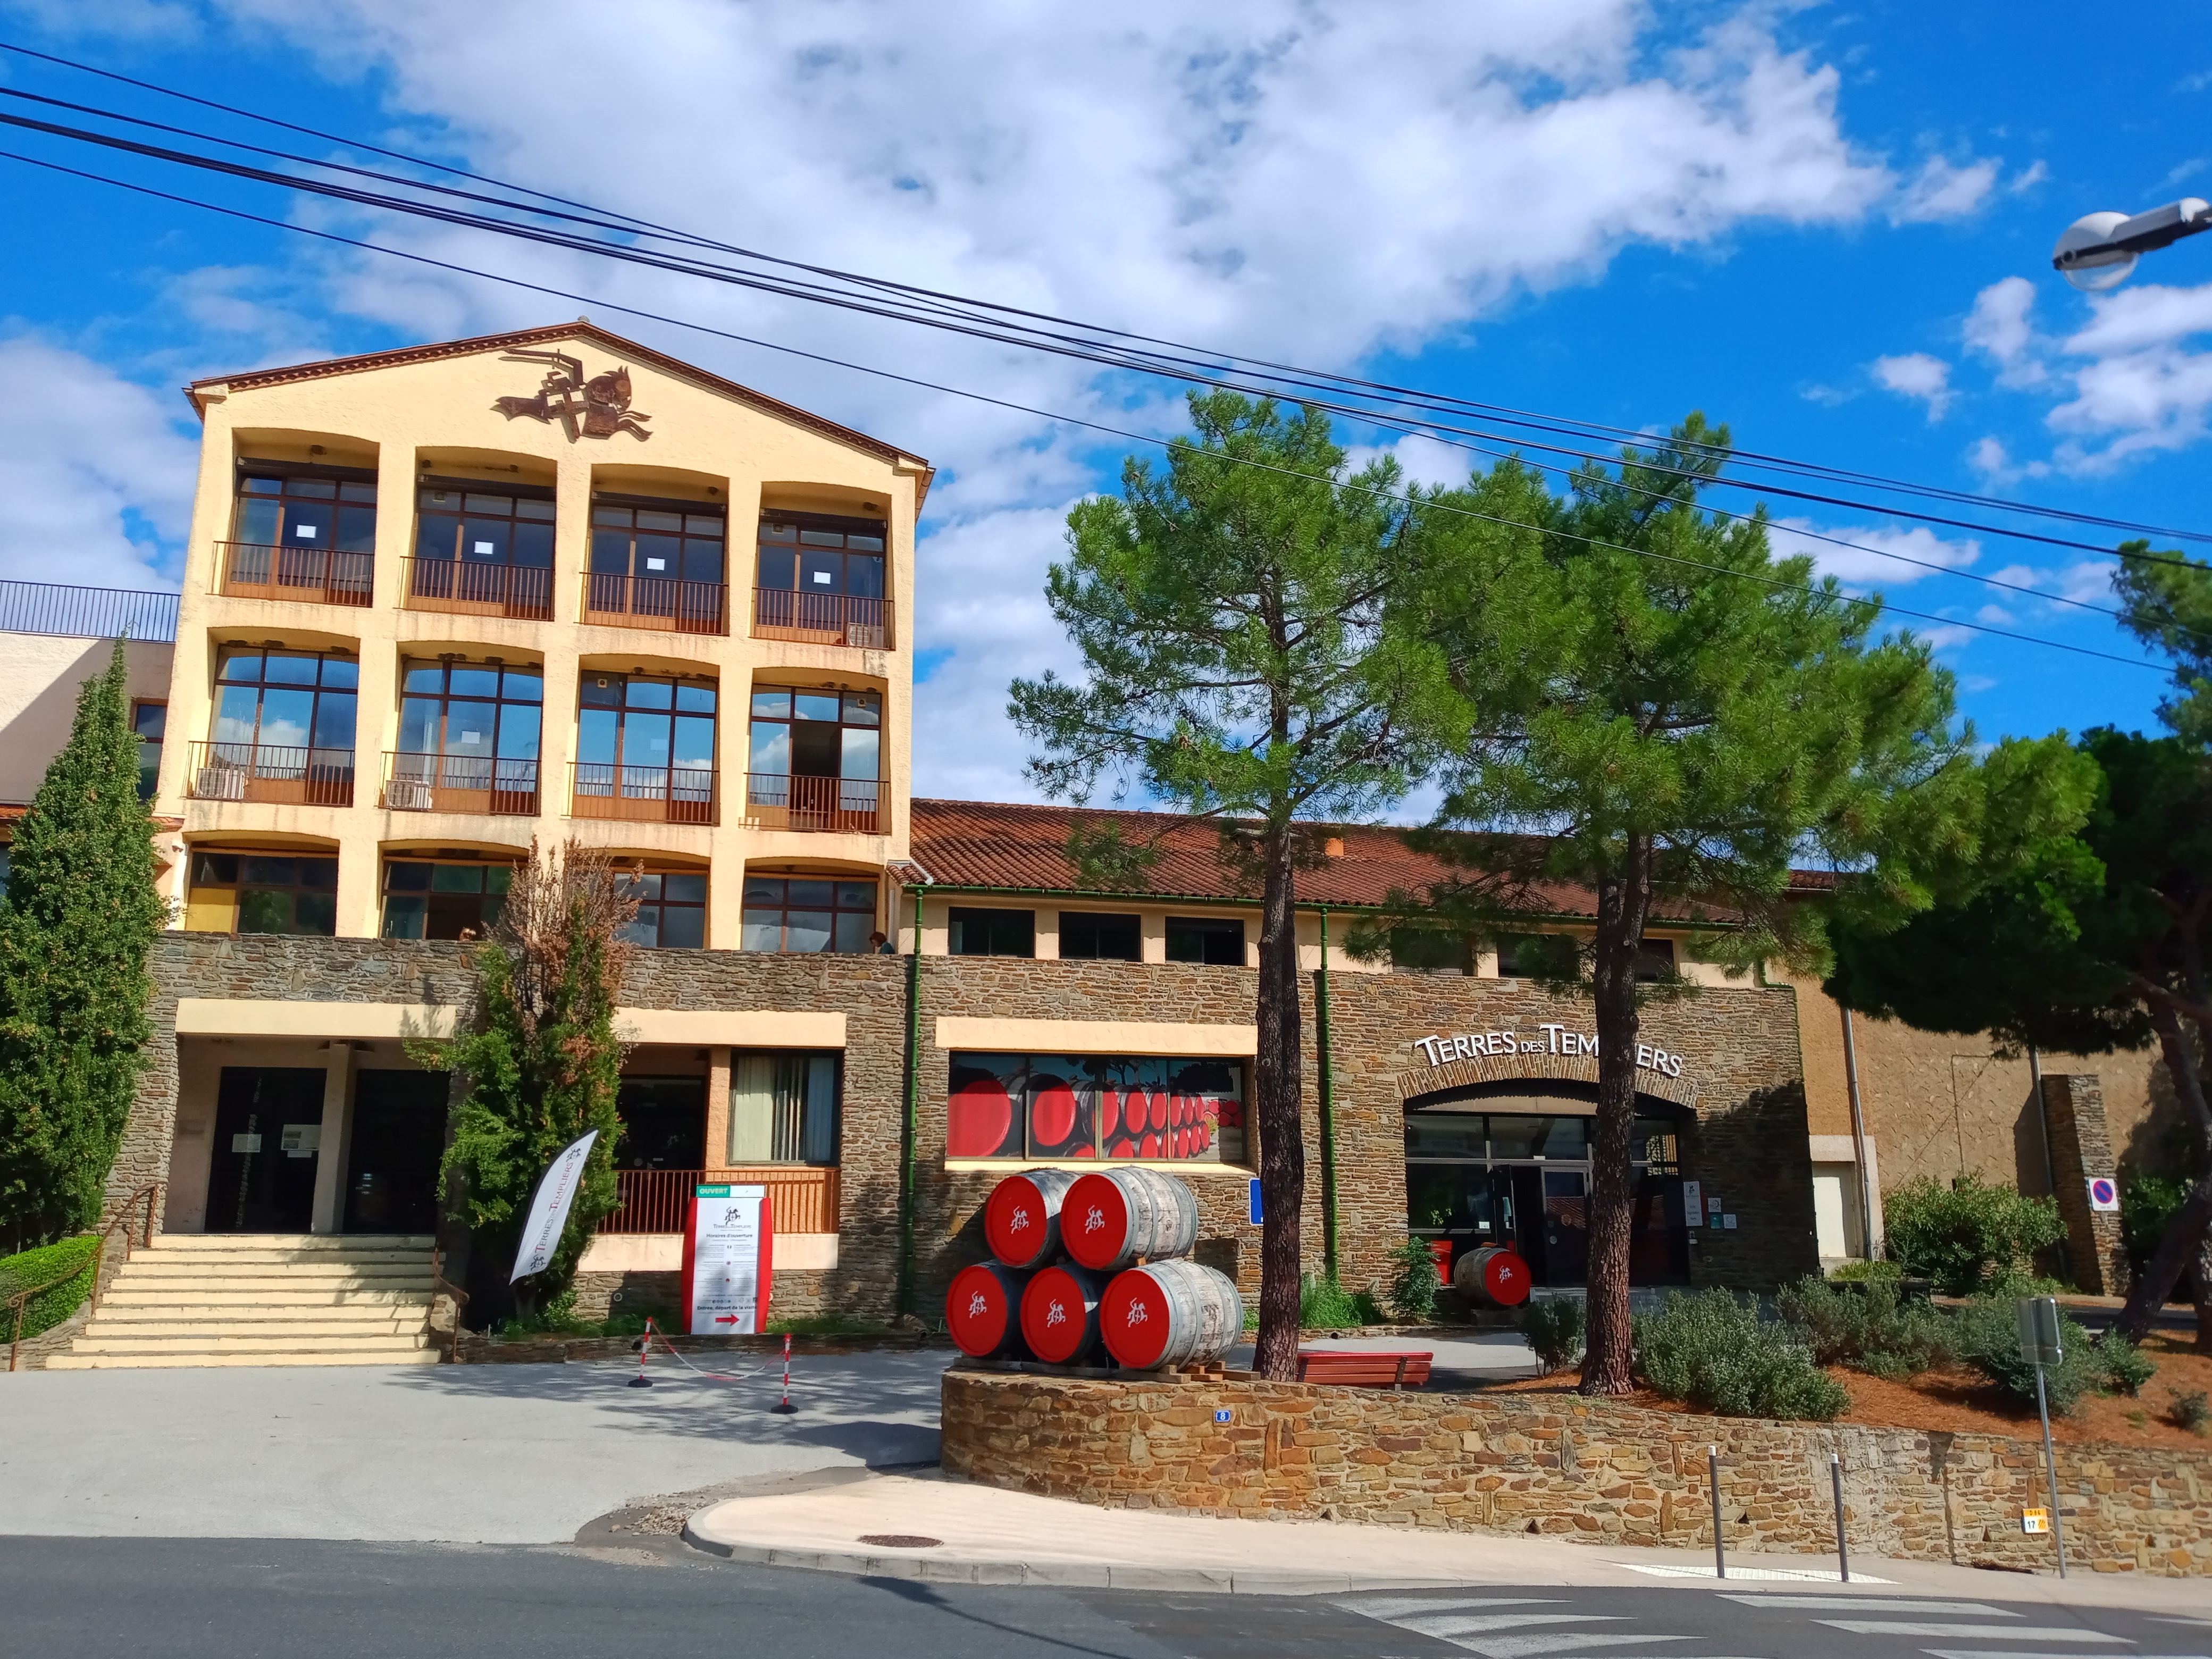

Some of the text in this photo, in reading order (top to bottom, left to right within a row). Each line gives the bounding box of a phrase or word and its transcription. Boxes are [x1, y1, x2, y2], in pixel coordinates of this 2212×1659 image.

[1414, 1024, 1682, 1077] TERRES DES TEMERS
[535, 1162, 573, 1253] TERRES TEMPLIERS
[2027, 1520, 2035, 1529] 17
